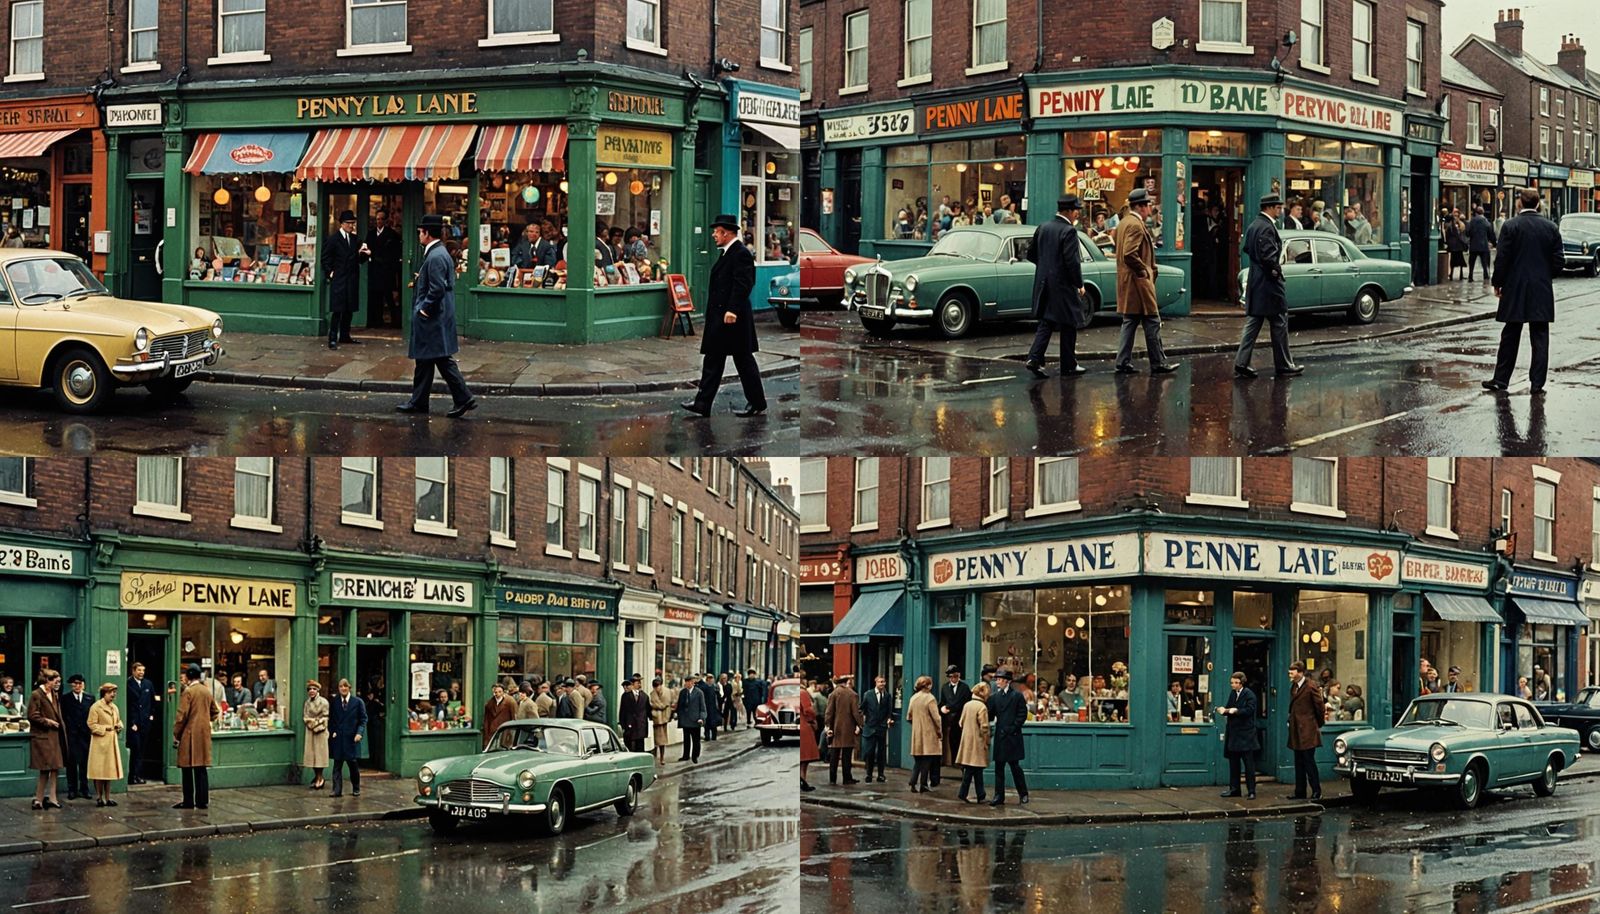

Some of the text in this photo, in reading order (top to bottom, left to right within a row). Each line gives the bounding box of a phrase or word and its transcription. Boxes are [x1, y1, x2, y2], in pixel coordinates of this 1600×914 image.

[296, 95, 369, 119] PENNY
[415, 92, 478, 114] LANE
[1210, 84, 1268, 112] BANE
[926, 100, 979, 130] PENNY
[1046, 540, 1116, 575] LANE
[1163, 539, 1261, 572] PENNE
[182, 582, 241, 606] PENNY
[248, 586, 293, 608] LANE
